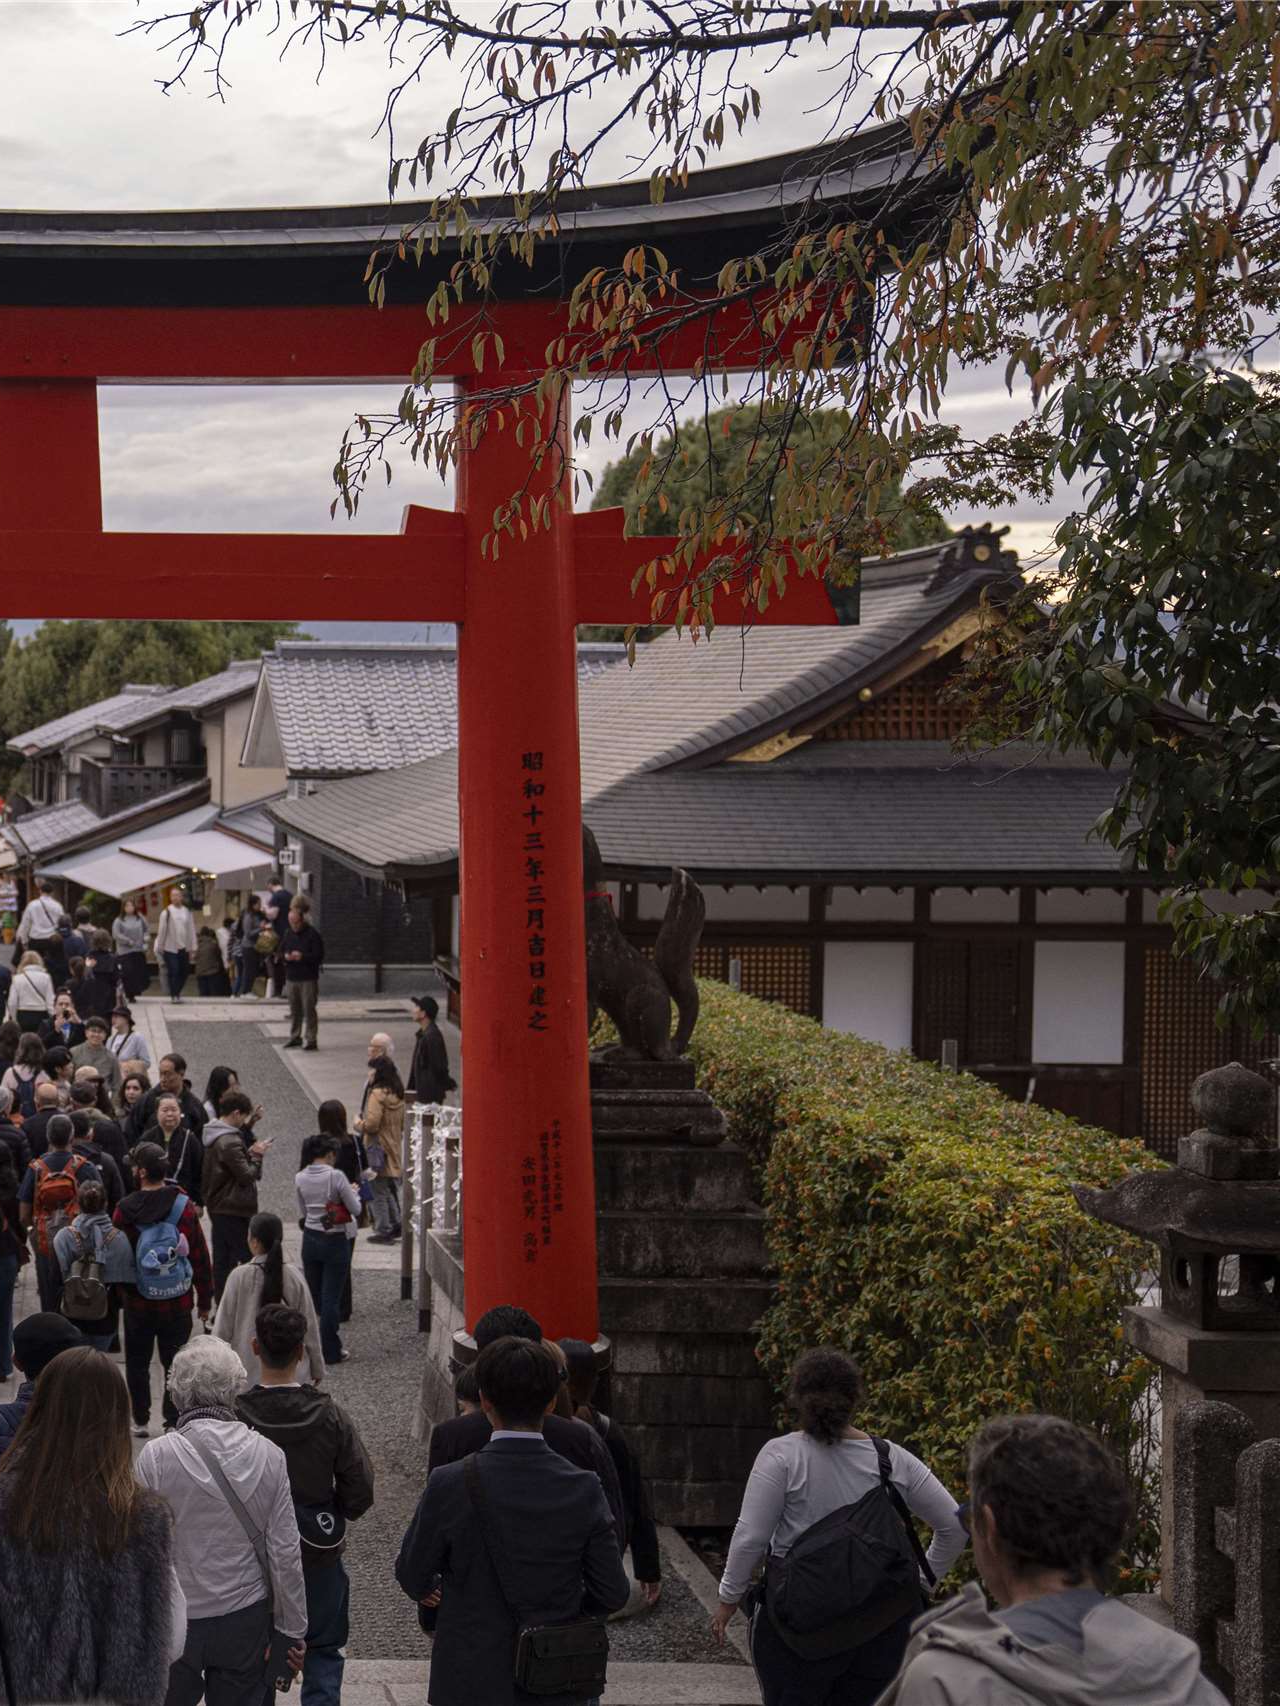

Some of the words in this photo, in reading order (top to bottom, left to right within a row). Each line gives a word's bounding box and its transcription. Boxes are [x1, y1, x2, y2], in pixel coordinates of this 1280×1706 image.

[521, 752, 548, 1032] 昭和十三年三月吉日建之
